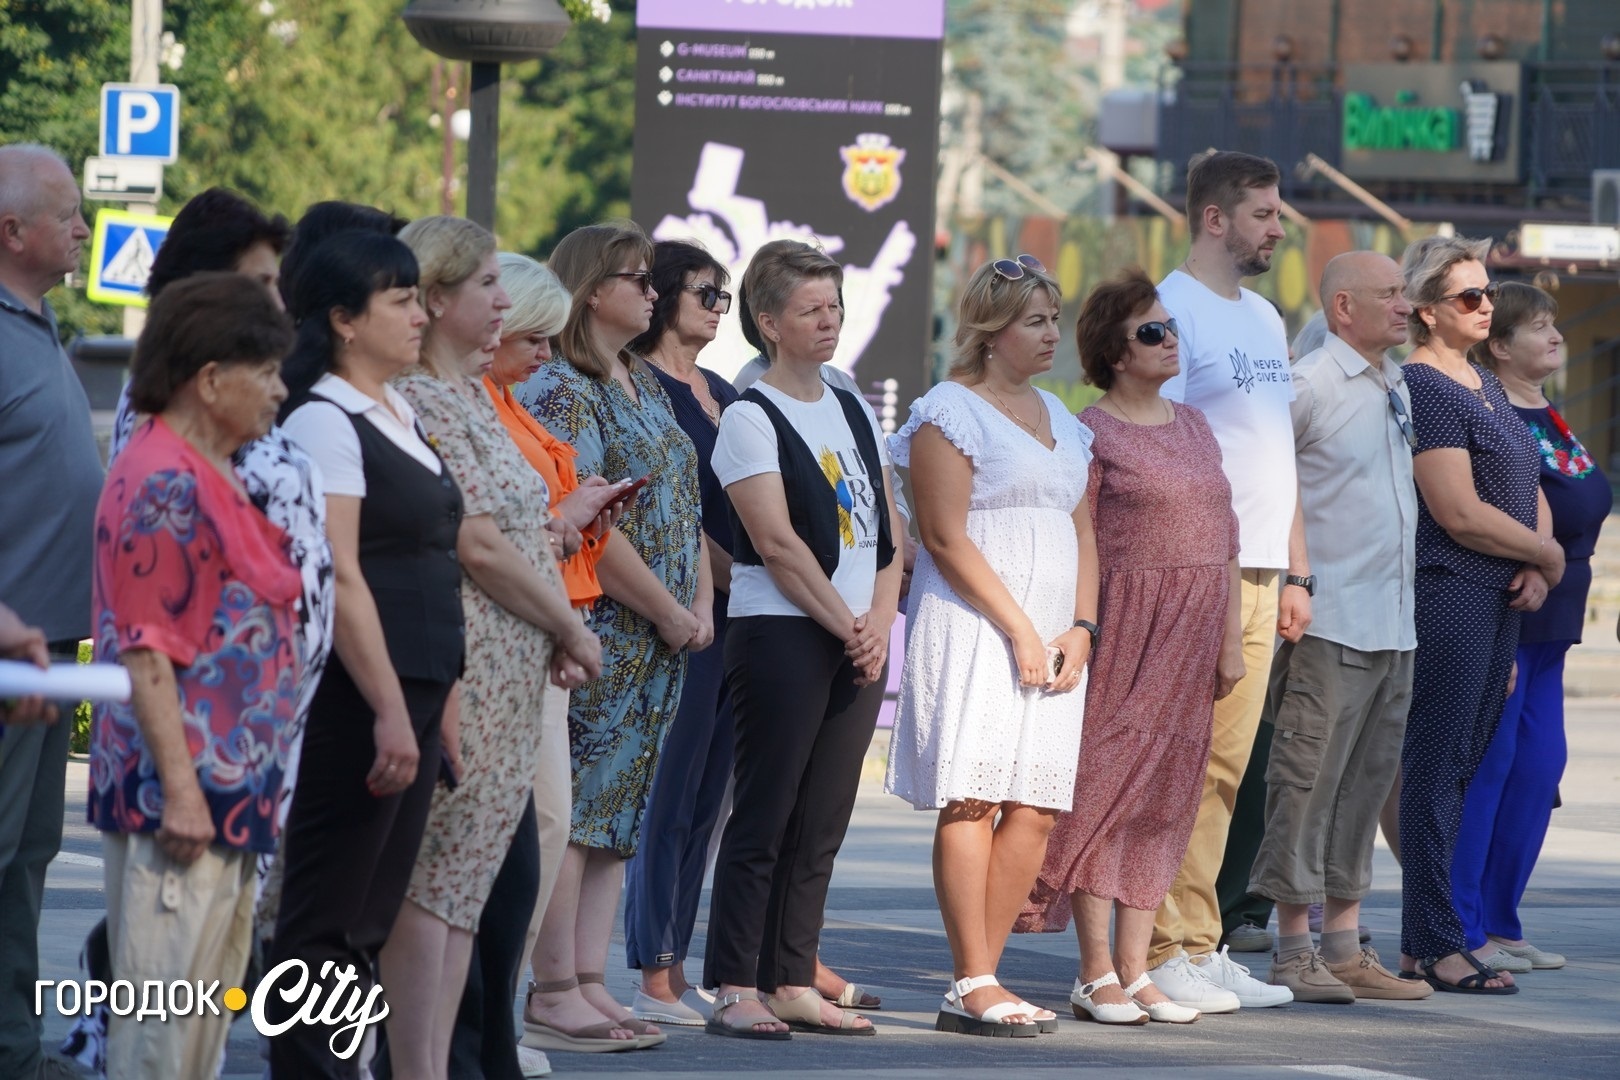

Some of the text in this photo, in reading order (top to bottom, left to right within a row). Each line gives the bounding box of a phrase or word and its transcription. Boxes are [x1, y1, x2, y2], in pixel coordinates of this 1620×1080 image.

[677, 42, 747, 58] G-MUSEUM
[117, 91, 161, 154] P
[1253, 359, 1283, 370] NEVER
[1256, 372, 1278, 382] GIVE
